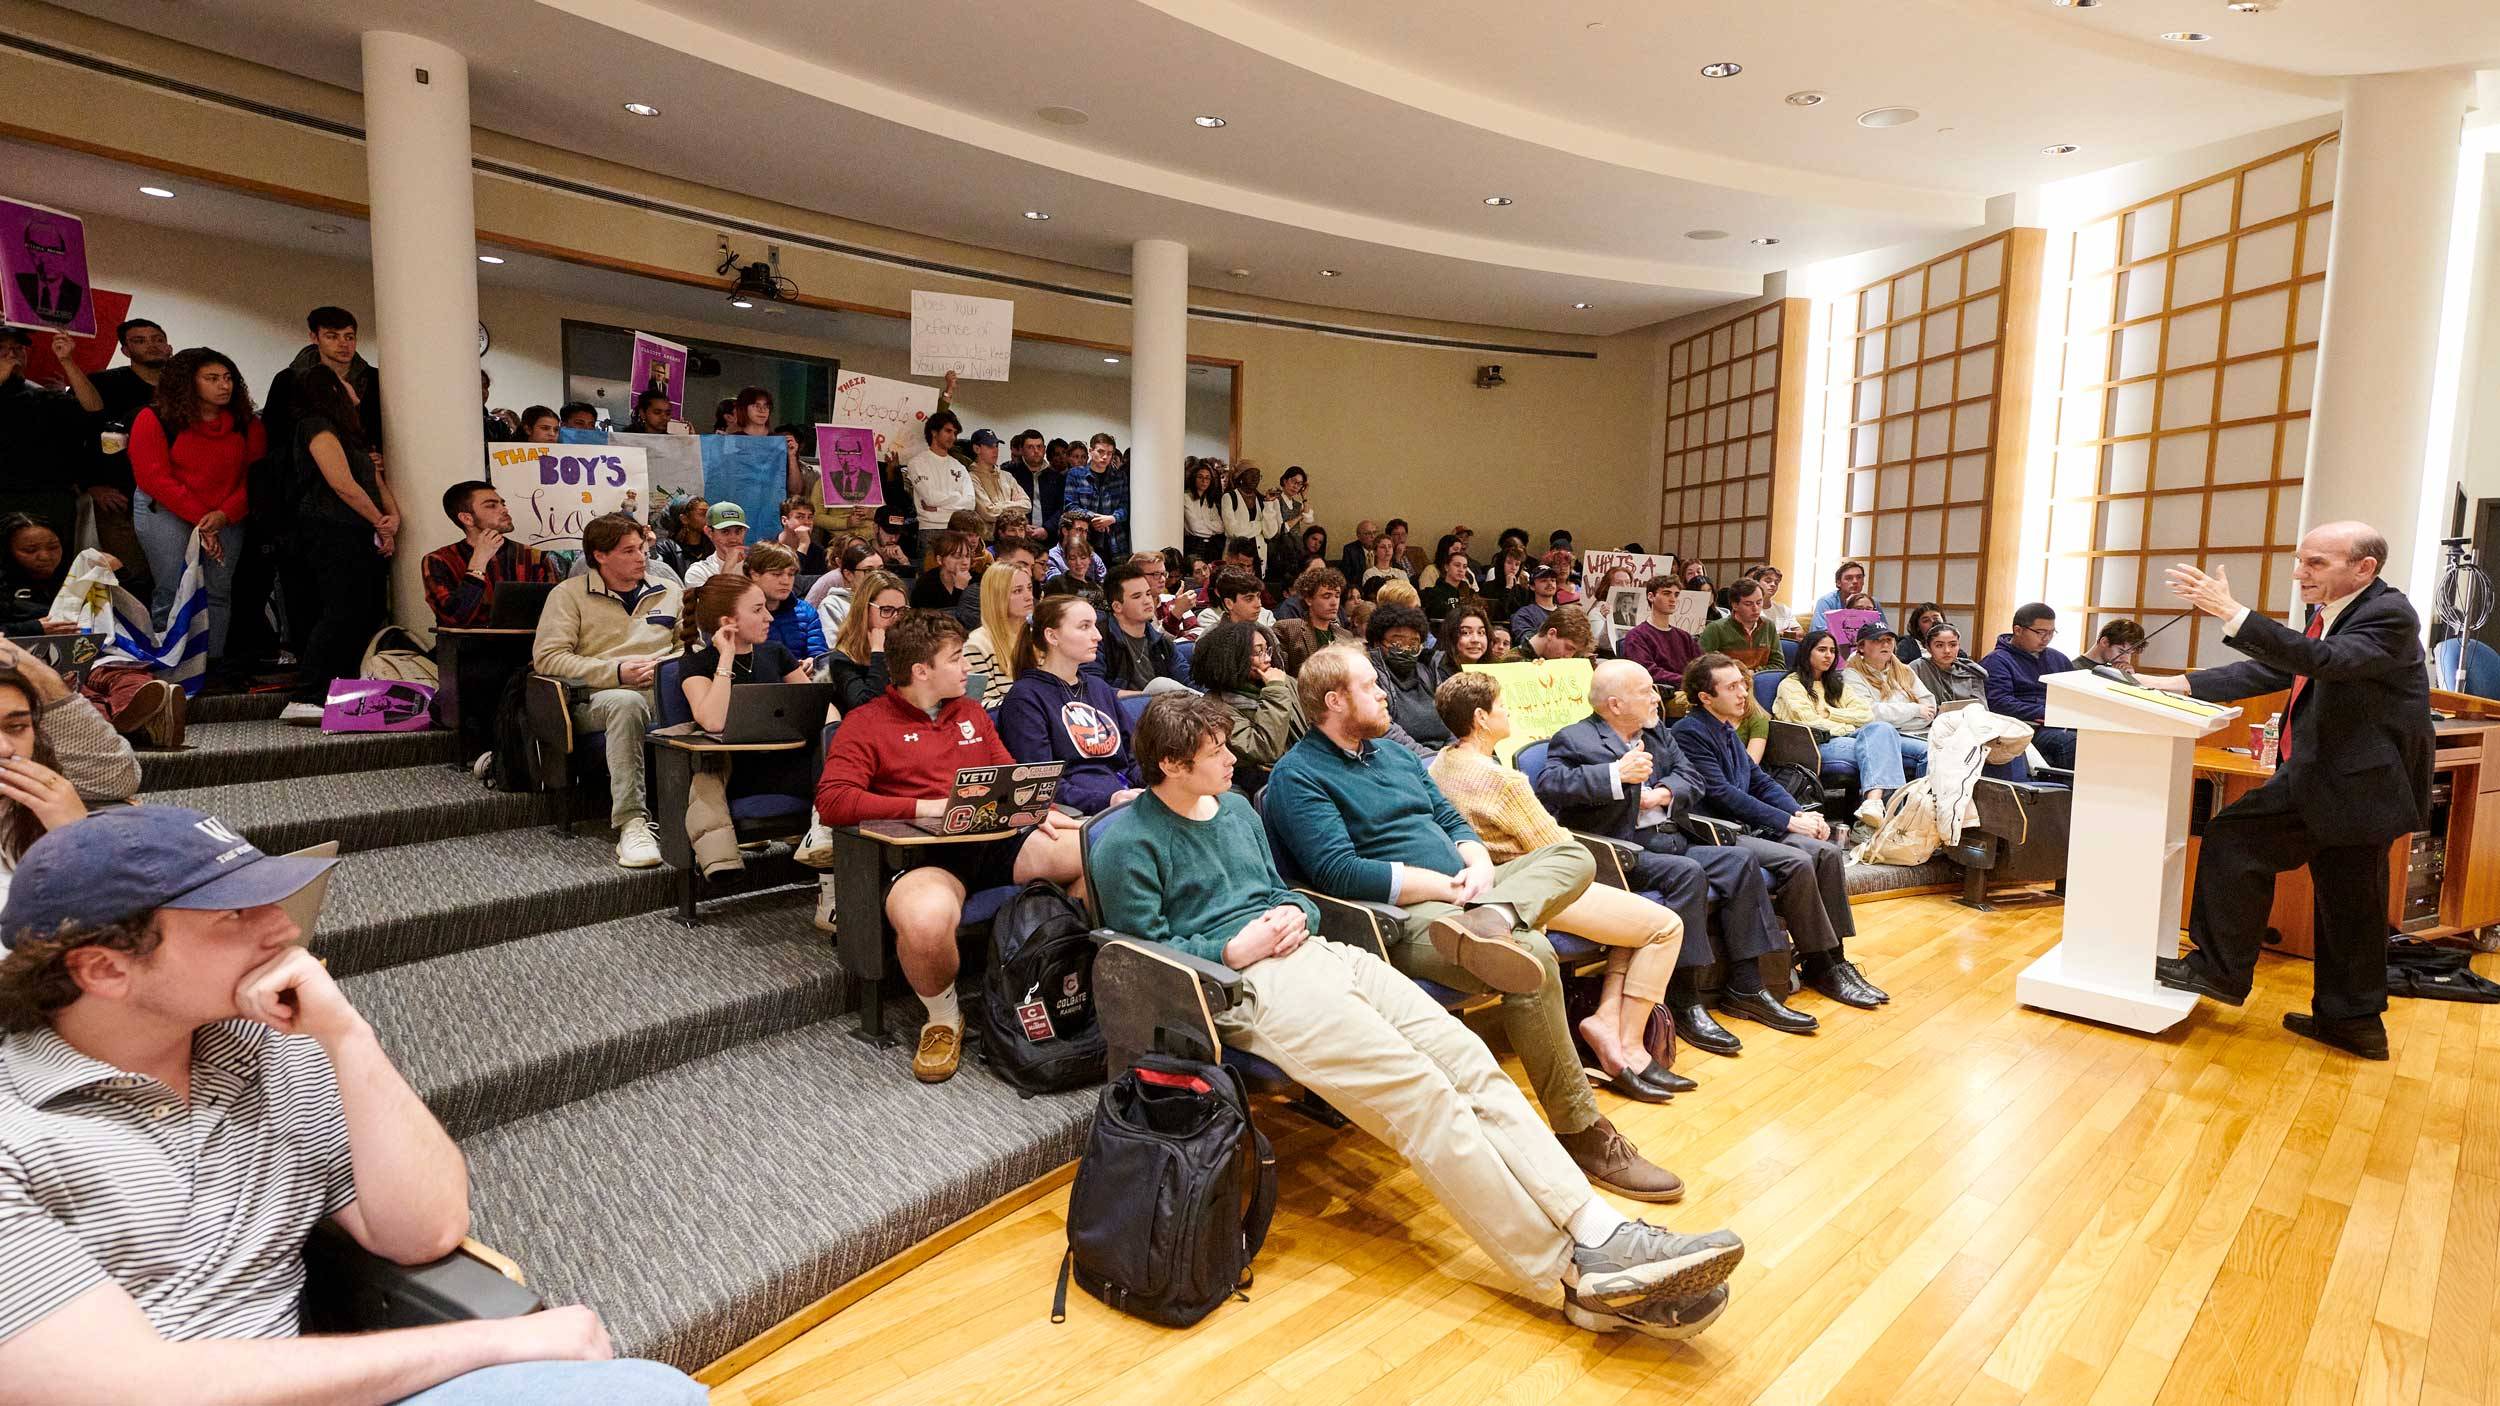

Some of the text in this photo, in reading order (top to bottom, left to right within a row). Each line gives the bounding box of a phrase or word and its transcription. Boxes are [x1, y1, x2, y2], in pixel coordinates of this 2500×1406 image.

[837, 377, 866, 393] THEIR
[492, 447, 550, 467] THAT
[539, 455, 627, 487] BOY'S
[581, 490, 593, 503] a
[1639, 556, 1656, 577] A
[961, 771, 994, 783] YETI
[946, 807, 974, 832] C
[1056, 992, 1087, 1009] COLGATE
[1027, 1008, 1038, 1018] C
